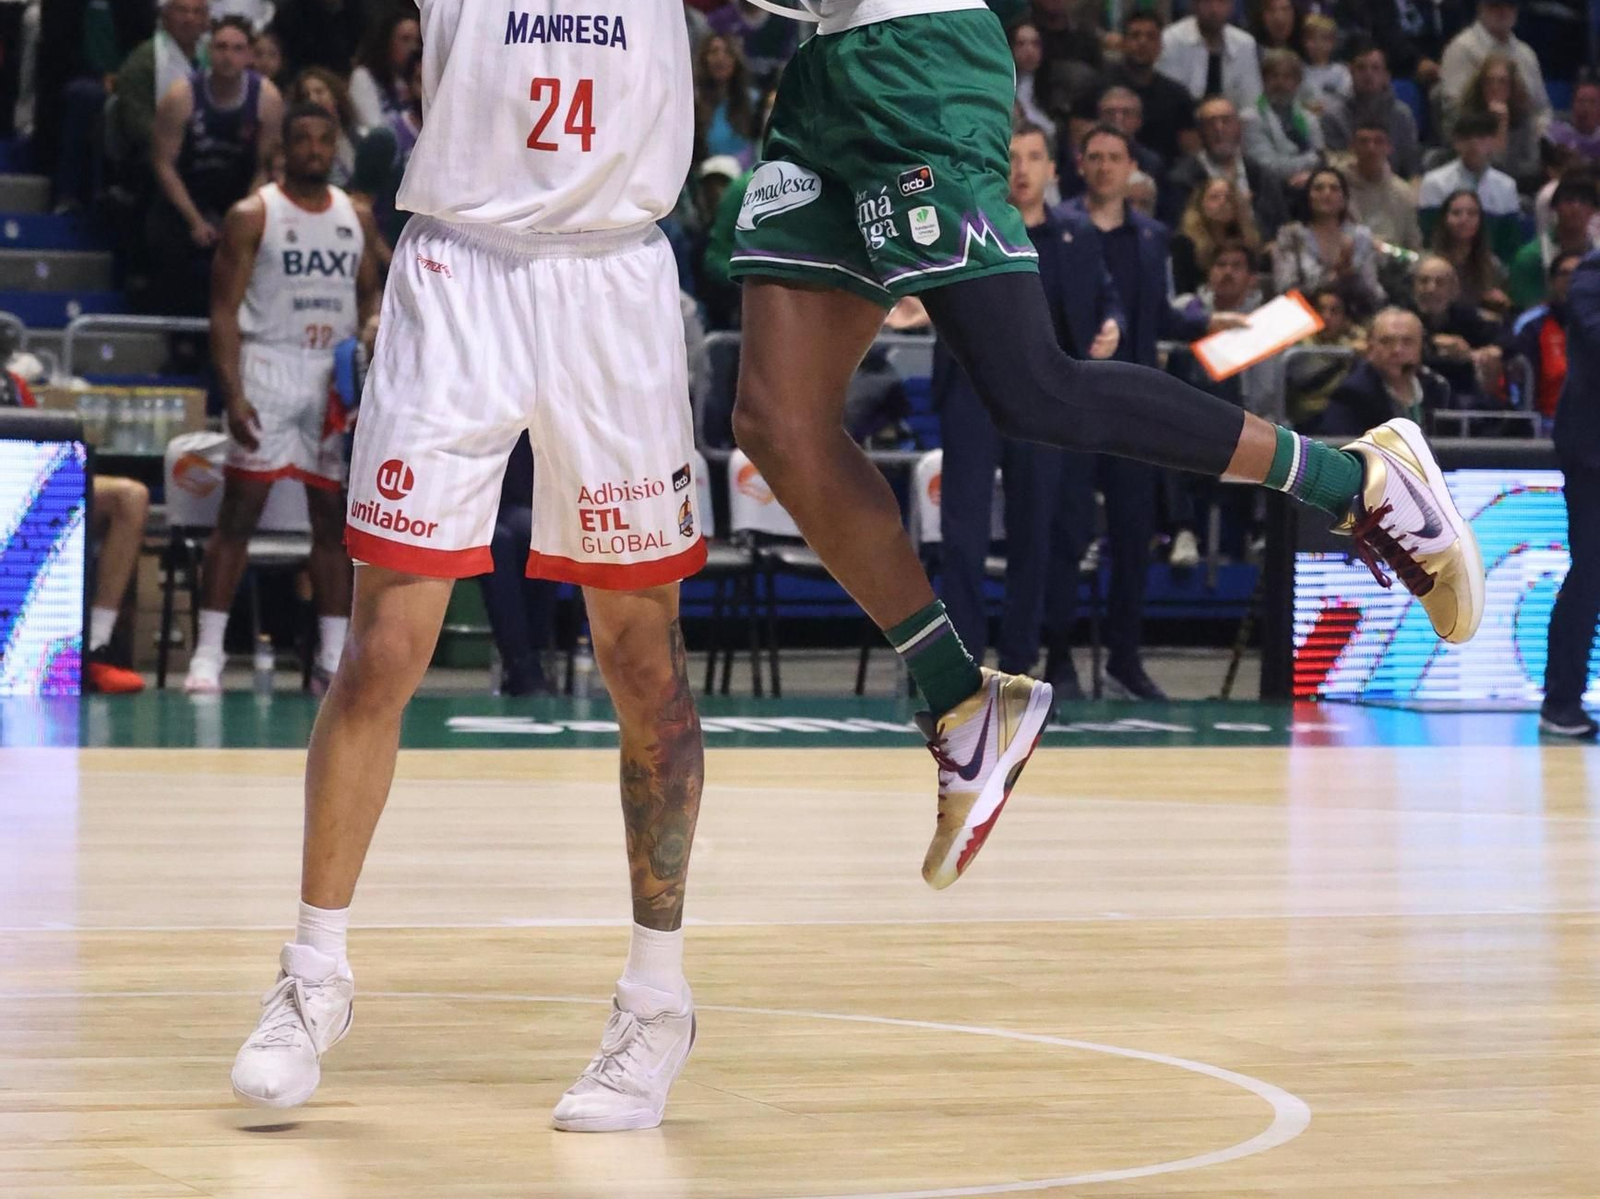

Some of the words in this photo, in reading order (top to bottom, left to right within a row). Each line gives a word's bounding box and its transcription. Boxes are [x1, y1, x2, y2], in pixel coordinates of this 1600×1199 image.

[504, 10, 627, 51] MANRESA
[526, 77, 596, 152] 24
[902, 178, 925, 192] acb
[283, 250, 358, 276] BAXI
[578, 478, 664, 505] Adbisio
[351, 500, 438, 538] unilabor
[579, 508, 630, 532] ETL
[582, 530, 672, 554] GLOBAL
